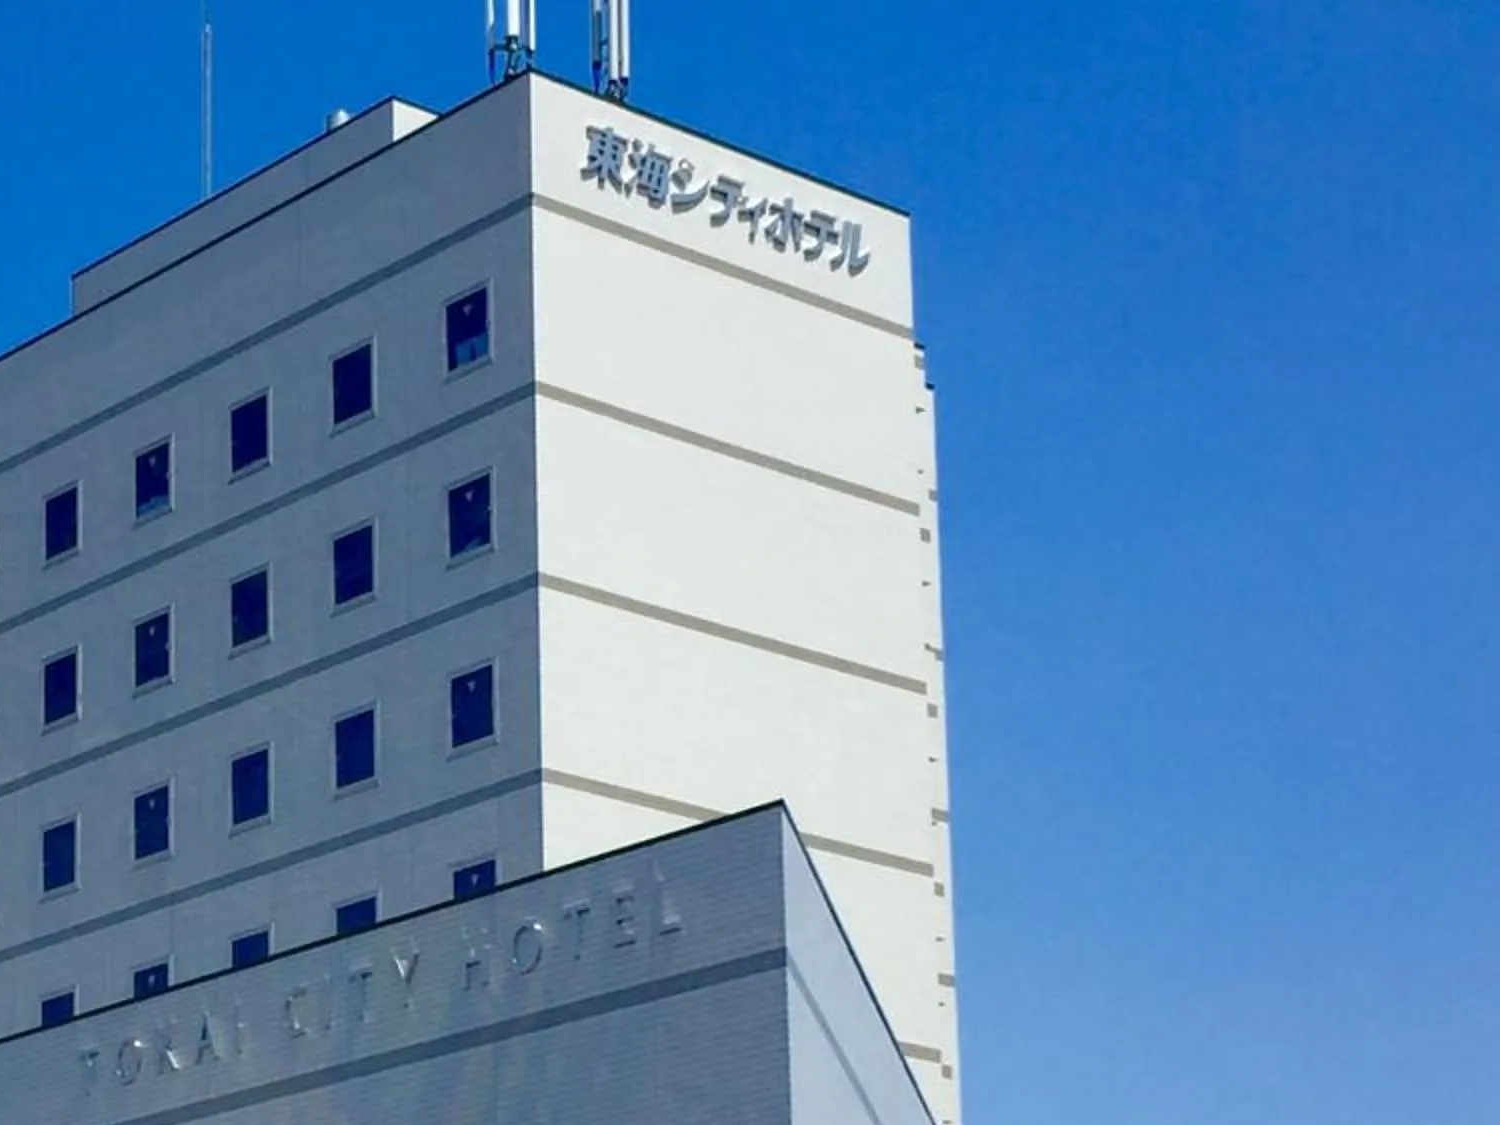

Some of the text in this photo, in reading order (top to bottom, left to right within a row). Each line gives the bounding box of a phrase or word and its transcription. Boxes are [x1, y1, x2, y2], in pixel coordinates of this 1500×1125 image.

[579, 124, 871, 278] 東海シティホテル
[79, 861, 683, 1097] TOKAI CITY HOTEL
